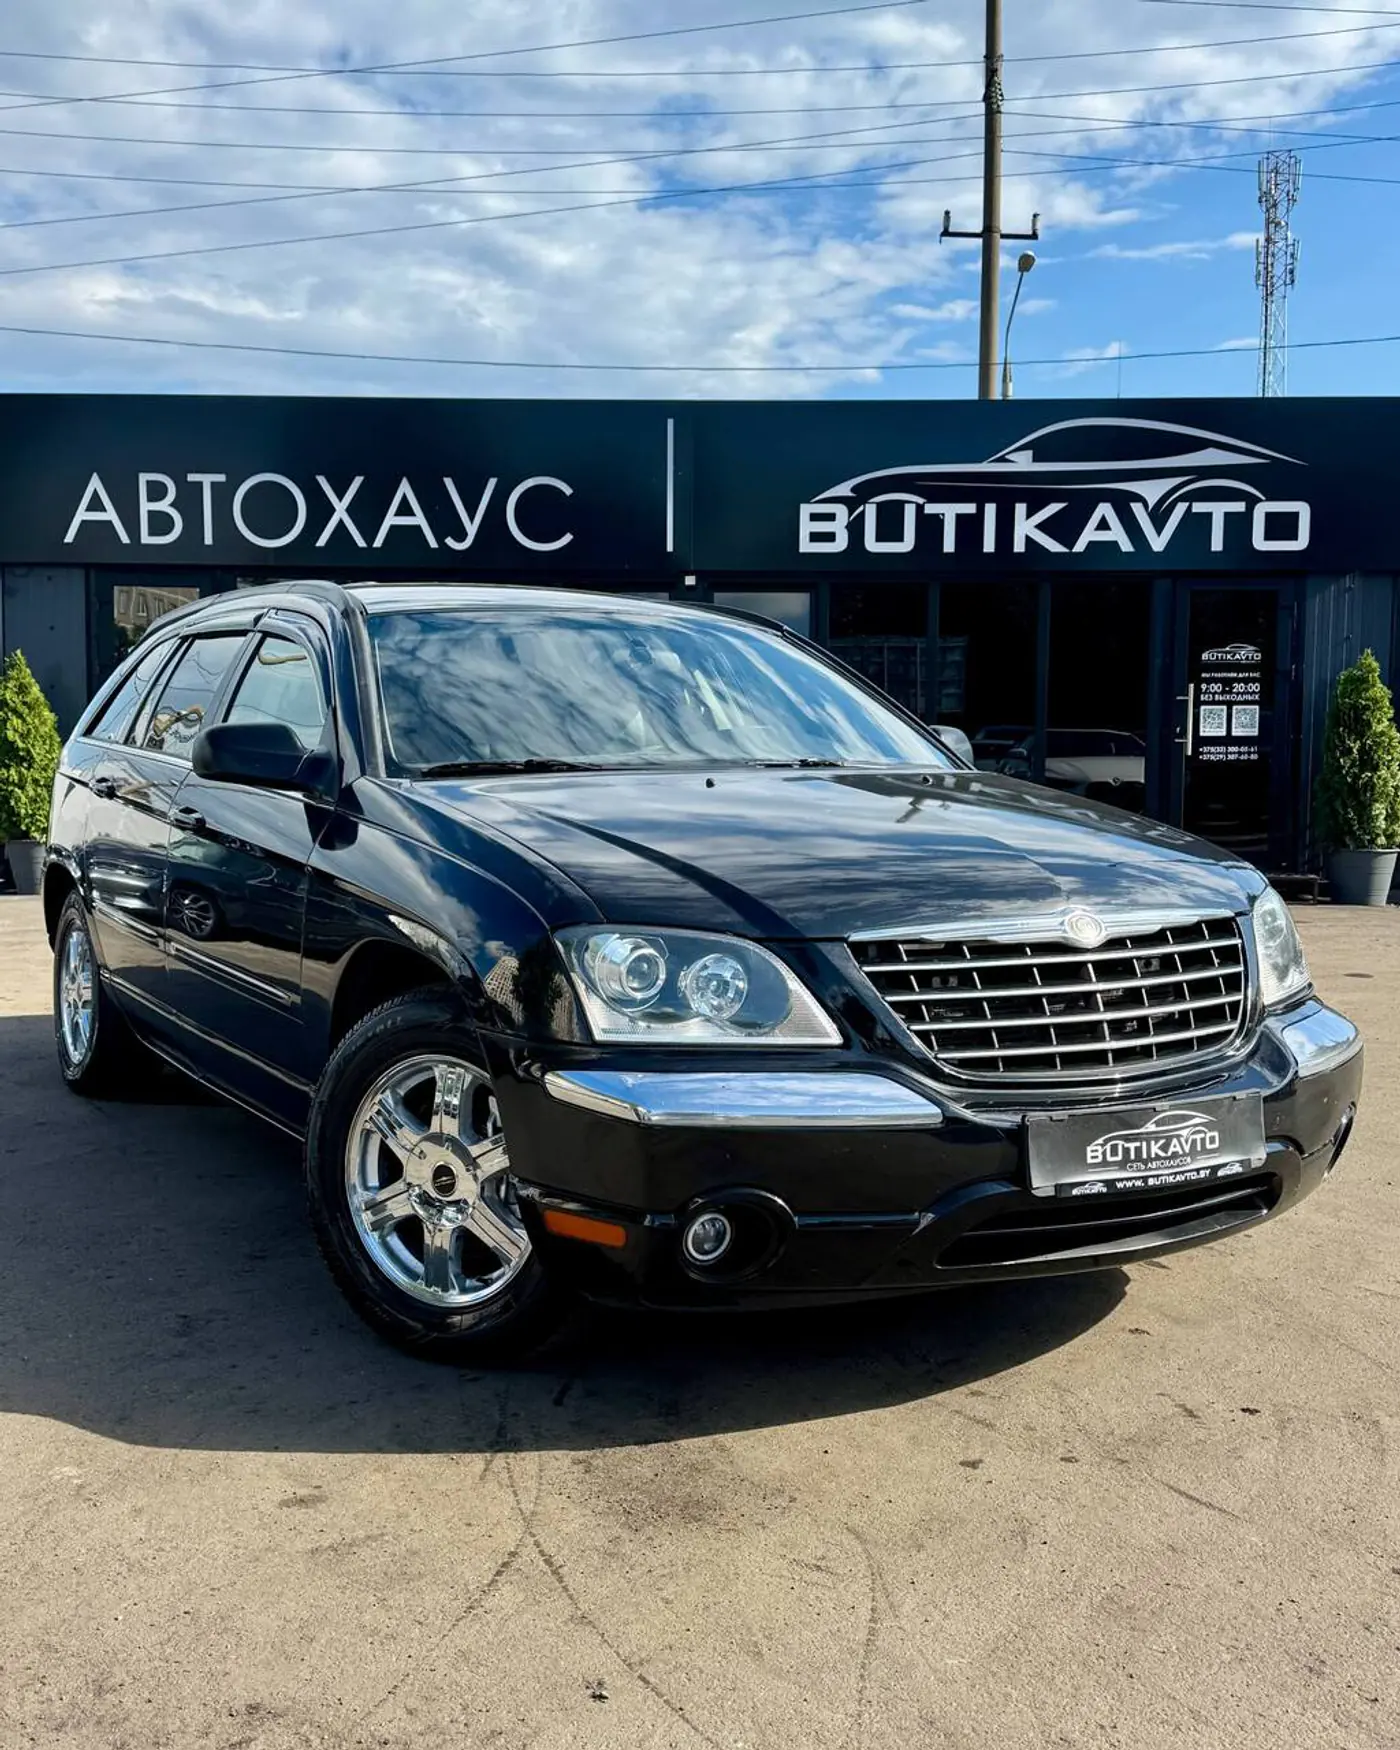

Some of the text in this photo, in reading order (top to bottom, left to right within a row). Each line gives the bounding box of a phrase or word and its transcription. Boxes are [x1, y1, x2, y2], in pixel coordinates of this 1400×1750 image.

[64, 472, 574, 551] АВТОХАУС
[799, 500, 1311, 553] BUTIKAVTO
[1201, 652, 1262, 660] BUTIKAVTO
[1201, 683, 1222, 692] 9:00
[1232, 682, 1260, 692] 20:00
[1214, 693, 1260, 701] ВЫХОДНЫХ
[1086, 1131, 1220, 1164] BUTIKAVTO
[1126, 1156, 1192, 1172] СЕТЬ АВТОХАУСОВ
[1115, 1179, 1145, 1189] WWW.
[1147, 1168, 1211, 1186] BUTIKAVTO.BY
